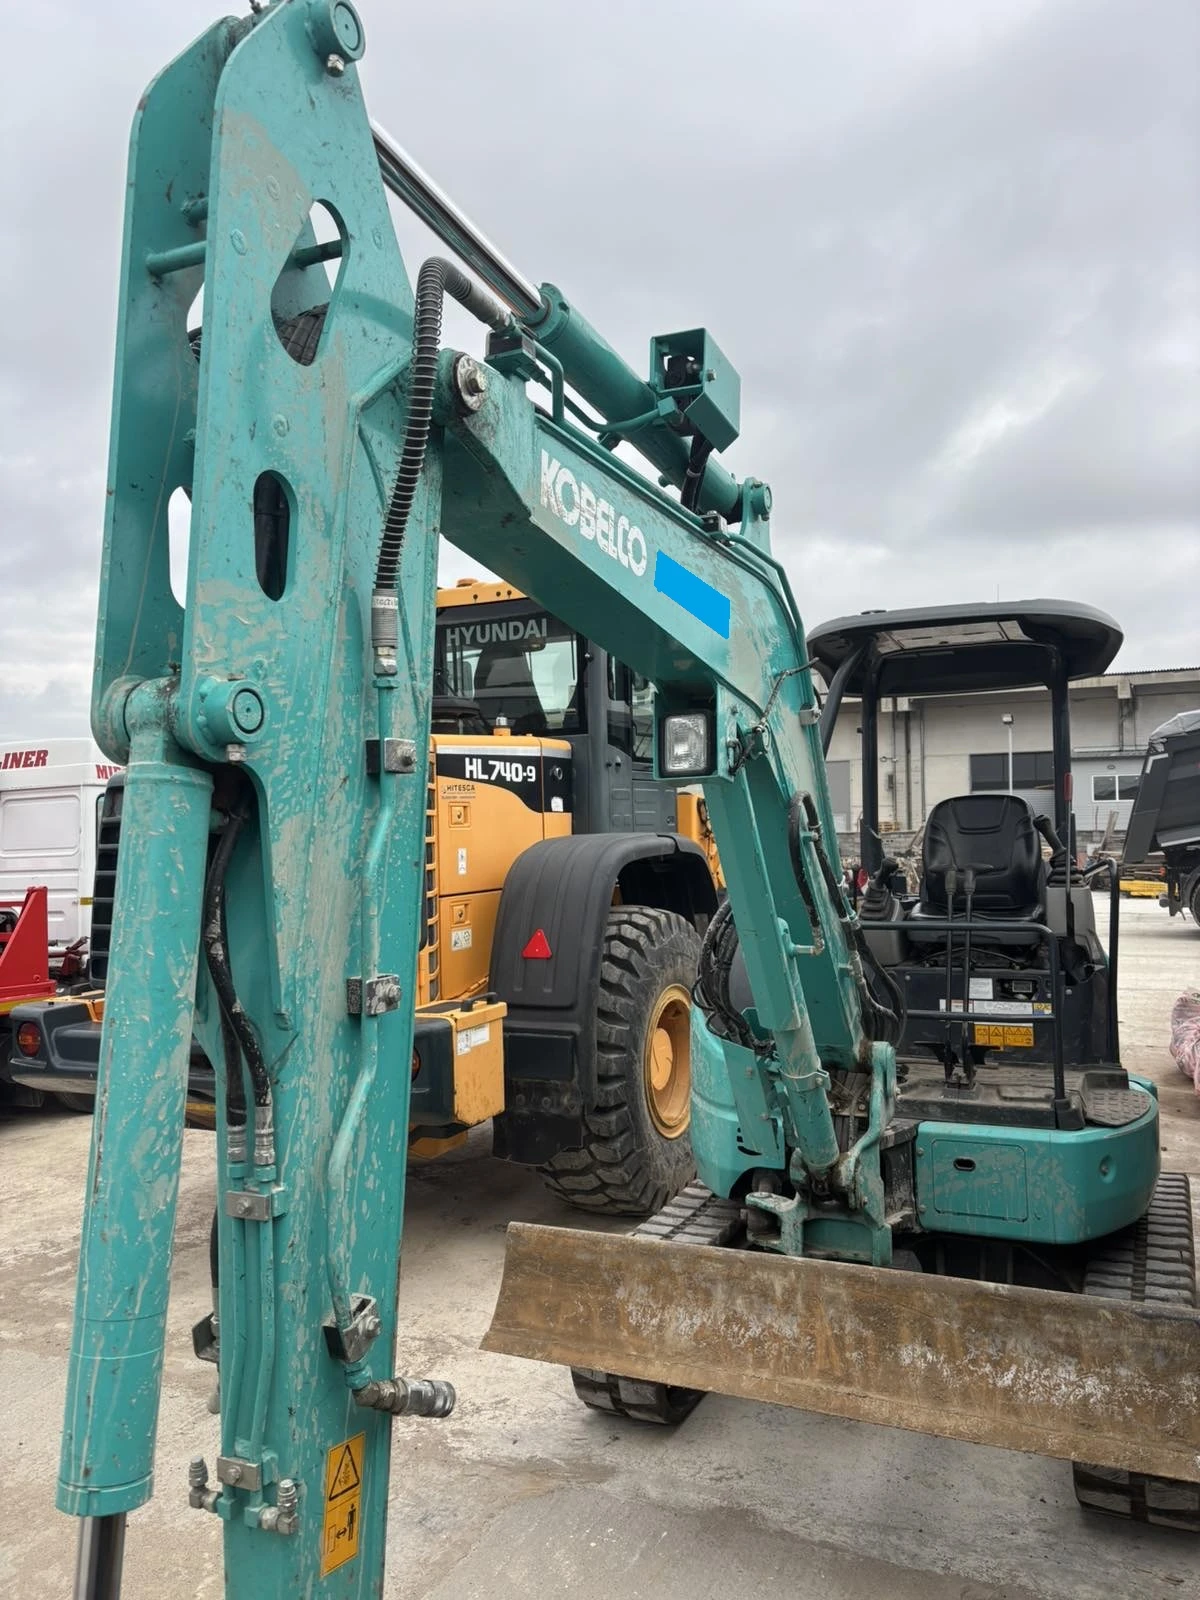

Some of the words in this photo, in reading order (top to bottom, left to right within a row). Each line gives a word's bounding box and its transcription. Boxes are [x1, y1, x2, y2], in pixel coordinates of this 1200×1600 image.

[540, 448, 647, 577] KOBELCO
[446, 618, 547, 645] HYUNDAI
[0, 750, 49, 769] INER
[465, 757, 536, 782] HL740-9
